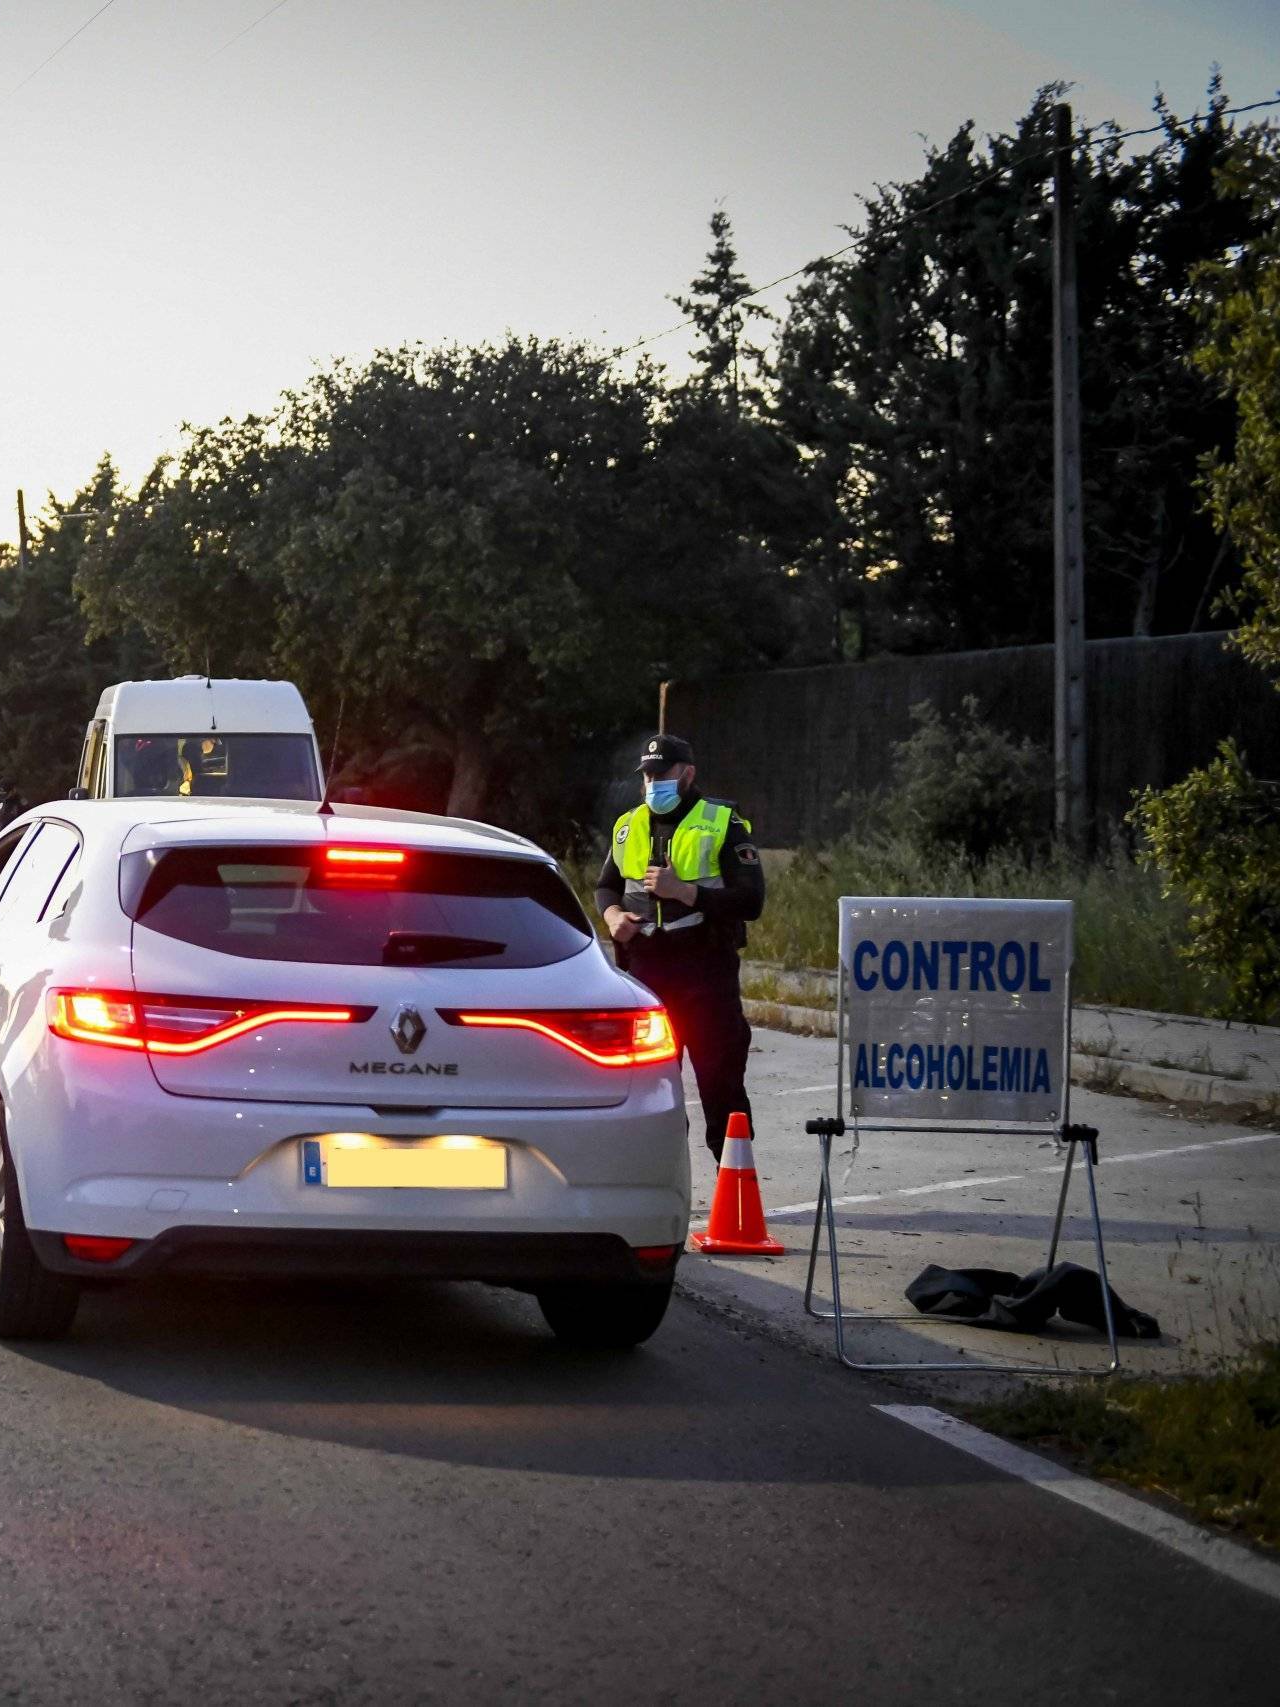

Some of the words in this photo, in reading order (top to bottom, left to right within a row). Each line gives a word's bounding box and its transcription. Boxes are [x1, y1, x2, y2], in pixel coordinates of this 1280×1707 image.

[853, 940, 1051, 992] CONTROL
[349, 1061, 459, 1076] MEGANE
[853, 1043, 1051, 1093] ALCOHOLEMIA
[309, 1166, 317, 1177] E
